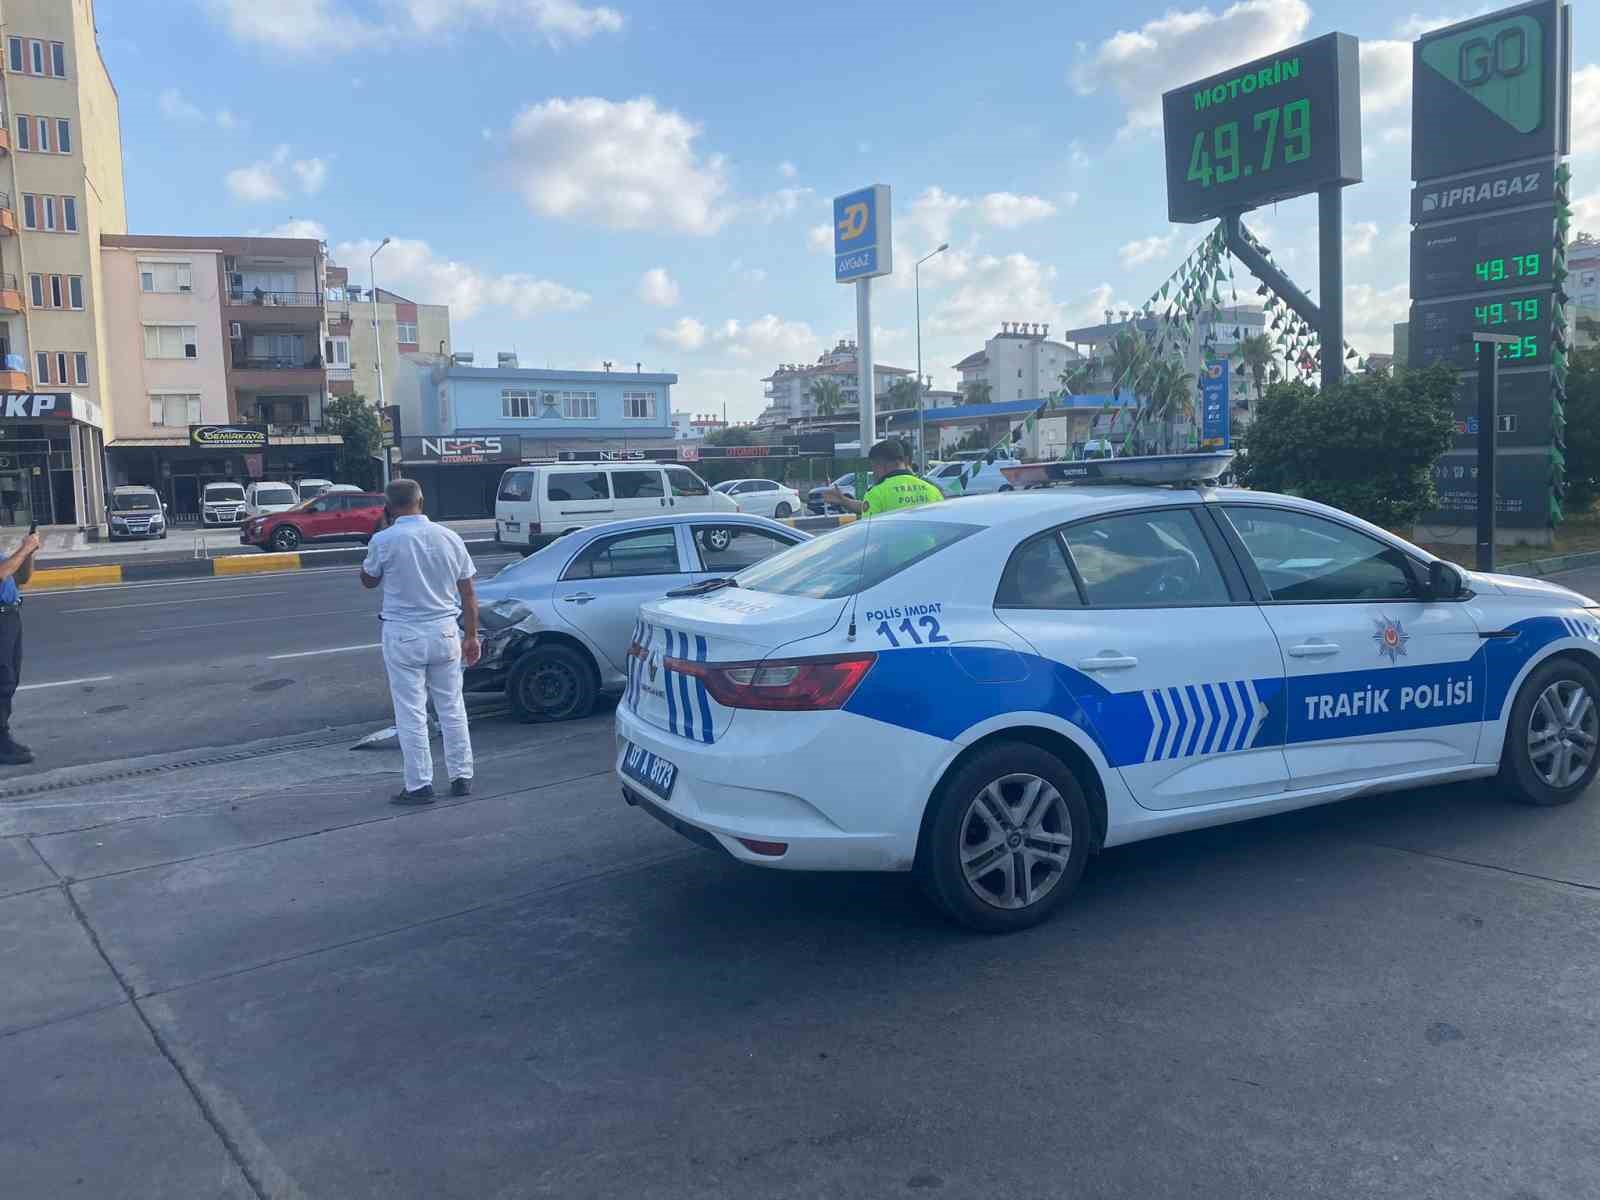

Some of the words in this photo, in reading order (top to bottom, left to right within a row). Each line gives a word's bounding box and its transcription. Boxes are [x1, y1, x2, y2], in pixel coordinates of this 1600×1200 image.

[1458, 26, 1528, 87] GO
[1193, 57, 1299, 111] MOTORİN
[1187, 98, 1311, 188] 49.79
[1475, 254, 1540, 281] 49.79
[1475, 298, 1538, 325] 49.79
[0, 394, 56, 417] KP
[421, 437, 502, 456] NEFES
[866, 606, 902, 622] POLİS
[904, 602, 942, 616] İMDAT
[876, 615, 950, 648] 112
[1305, 685, 1390, 721] TRAFİK
[1400, 675, 1473, 710] POLİSİ
[651, 757, 673, 789] 8173
